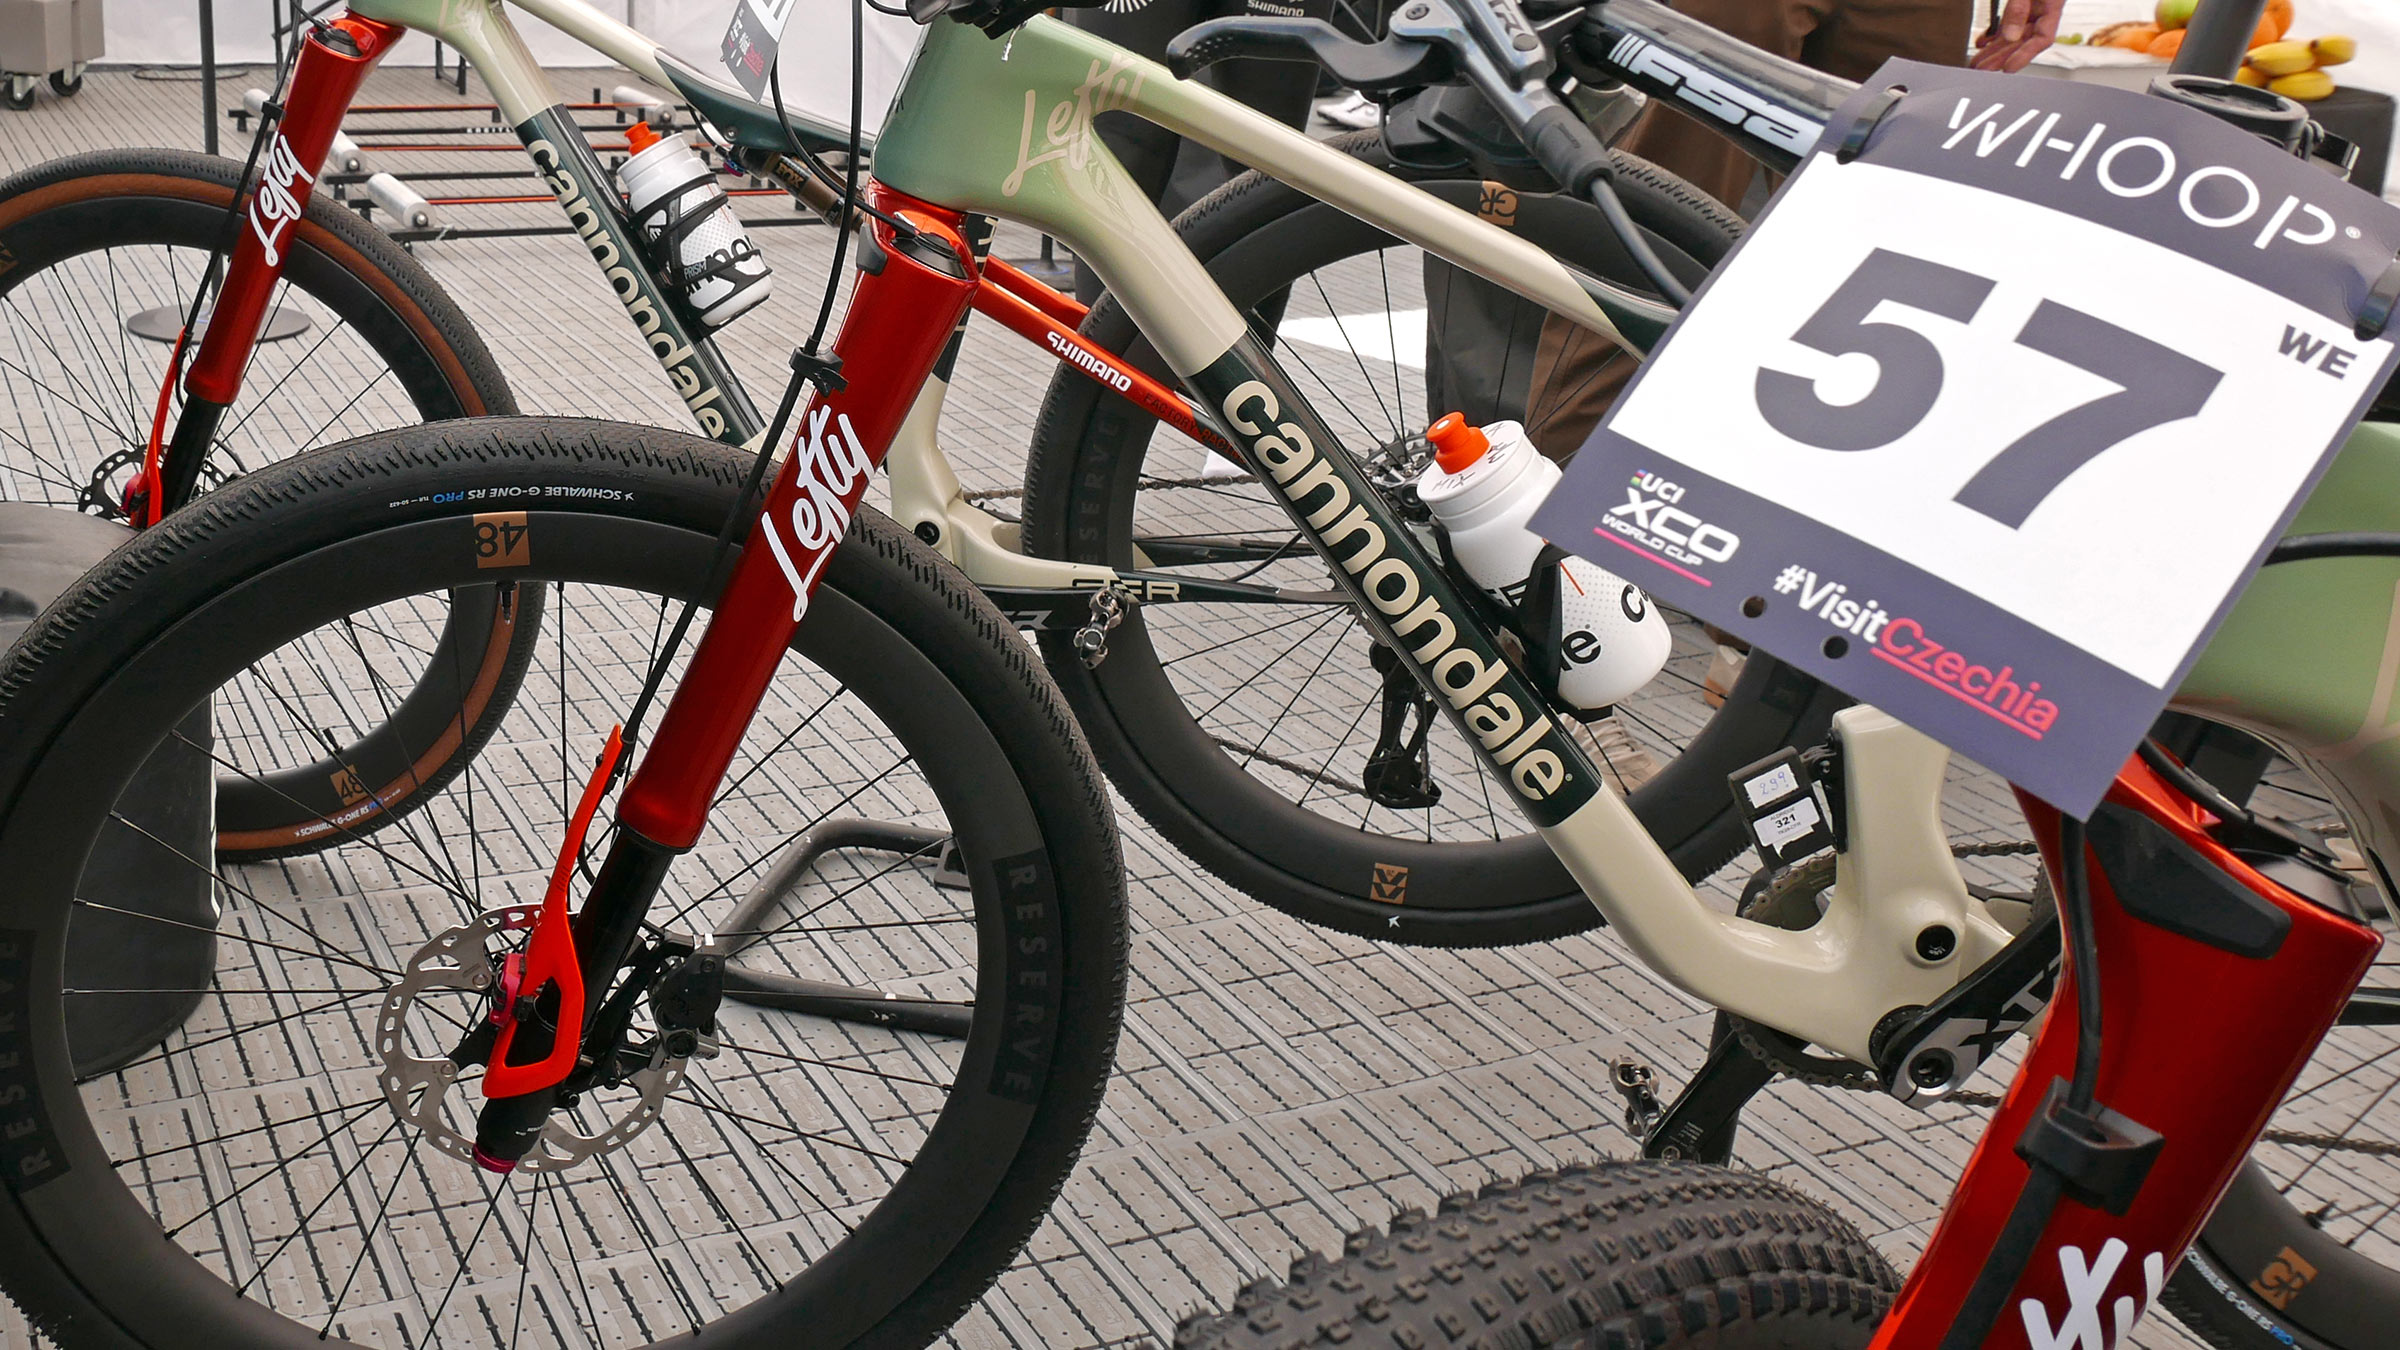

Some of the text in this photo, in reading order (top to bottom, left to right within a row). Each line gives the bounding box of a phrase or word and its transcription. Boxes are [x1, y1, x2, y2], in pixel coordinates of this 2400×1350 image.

[1247, 0, 1305, 17] SHIMANO
[249, 130, 314, 267] Lefty
[528, 138, 725, 440] cannondale
[1047, 330, 1133, 393] SHIMANO
[2278, 323, 2358, 381] WE
[1754, 246, 2227, 532] 57
[433, 490, 465, 504] PRO
[468, 488, 486, 500] RS
[489, 486, 541, 498] G-ONE
[545, 486, 622, 501] SCHWALBE
[761, 404, 876, 623] Lefty
[1640, 472, 1686, 504] UCI
[475, 521, 528, 558] 48
[1601, 513, 1704, 566] WORLD CUP
[1609, 487, 1740, 563] XCO
[1222, 380, 1566, 800] cannondale
[1775, 813, 1796, 828] 321
[1003, 864, 1048, 1092] RESERVE
[2269, 1325, 2294, 1346] PRO
